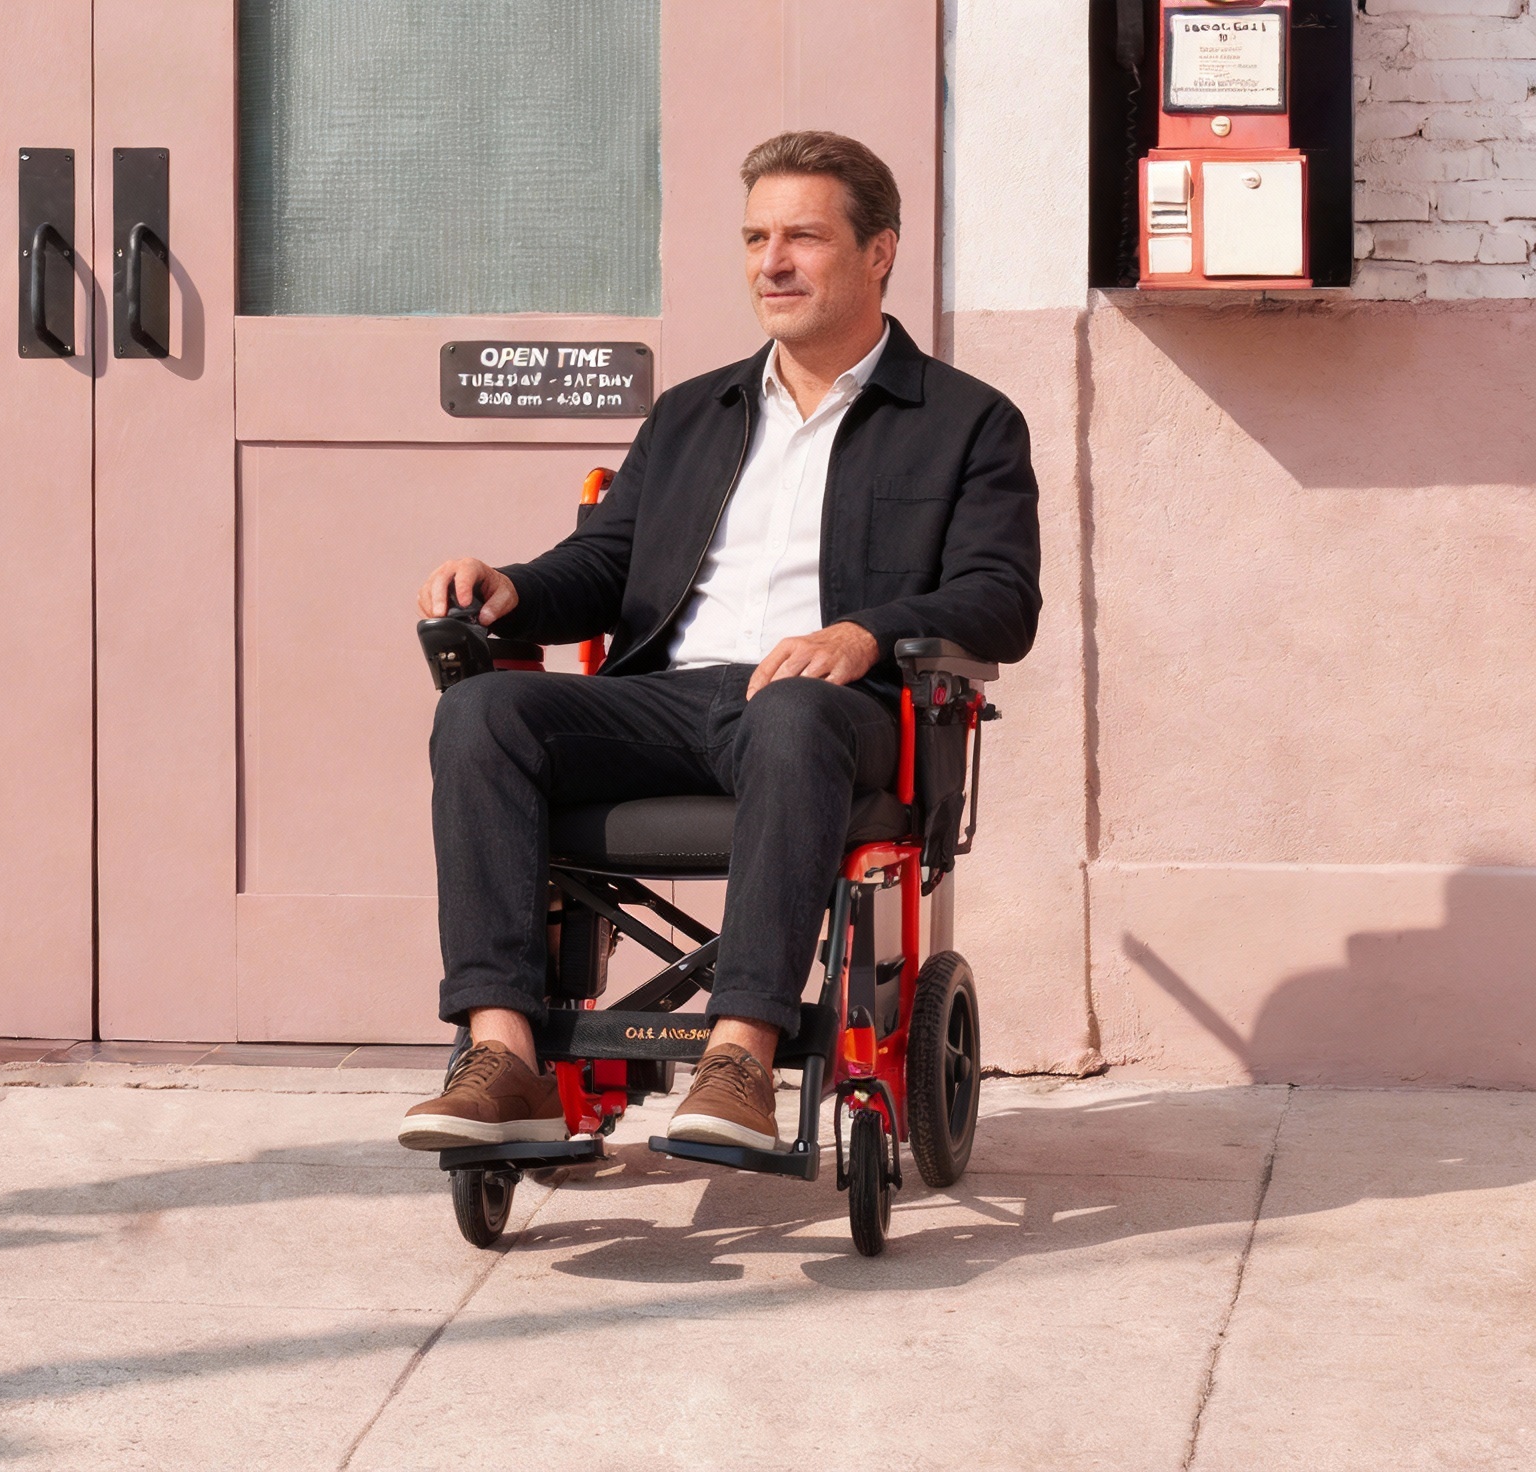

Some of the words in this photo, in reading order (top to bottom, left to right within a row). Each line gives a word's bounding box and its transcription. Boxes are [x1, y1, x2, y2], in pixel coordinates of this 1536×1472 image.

[480, 347, 549, 369] OPEN
[557, 348, 613, 368] TIME
[597, 394, 622, 409] pm
